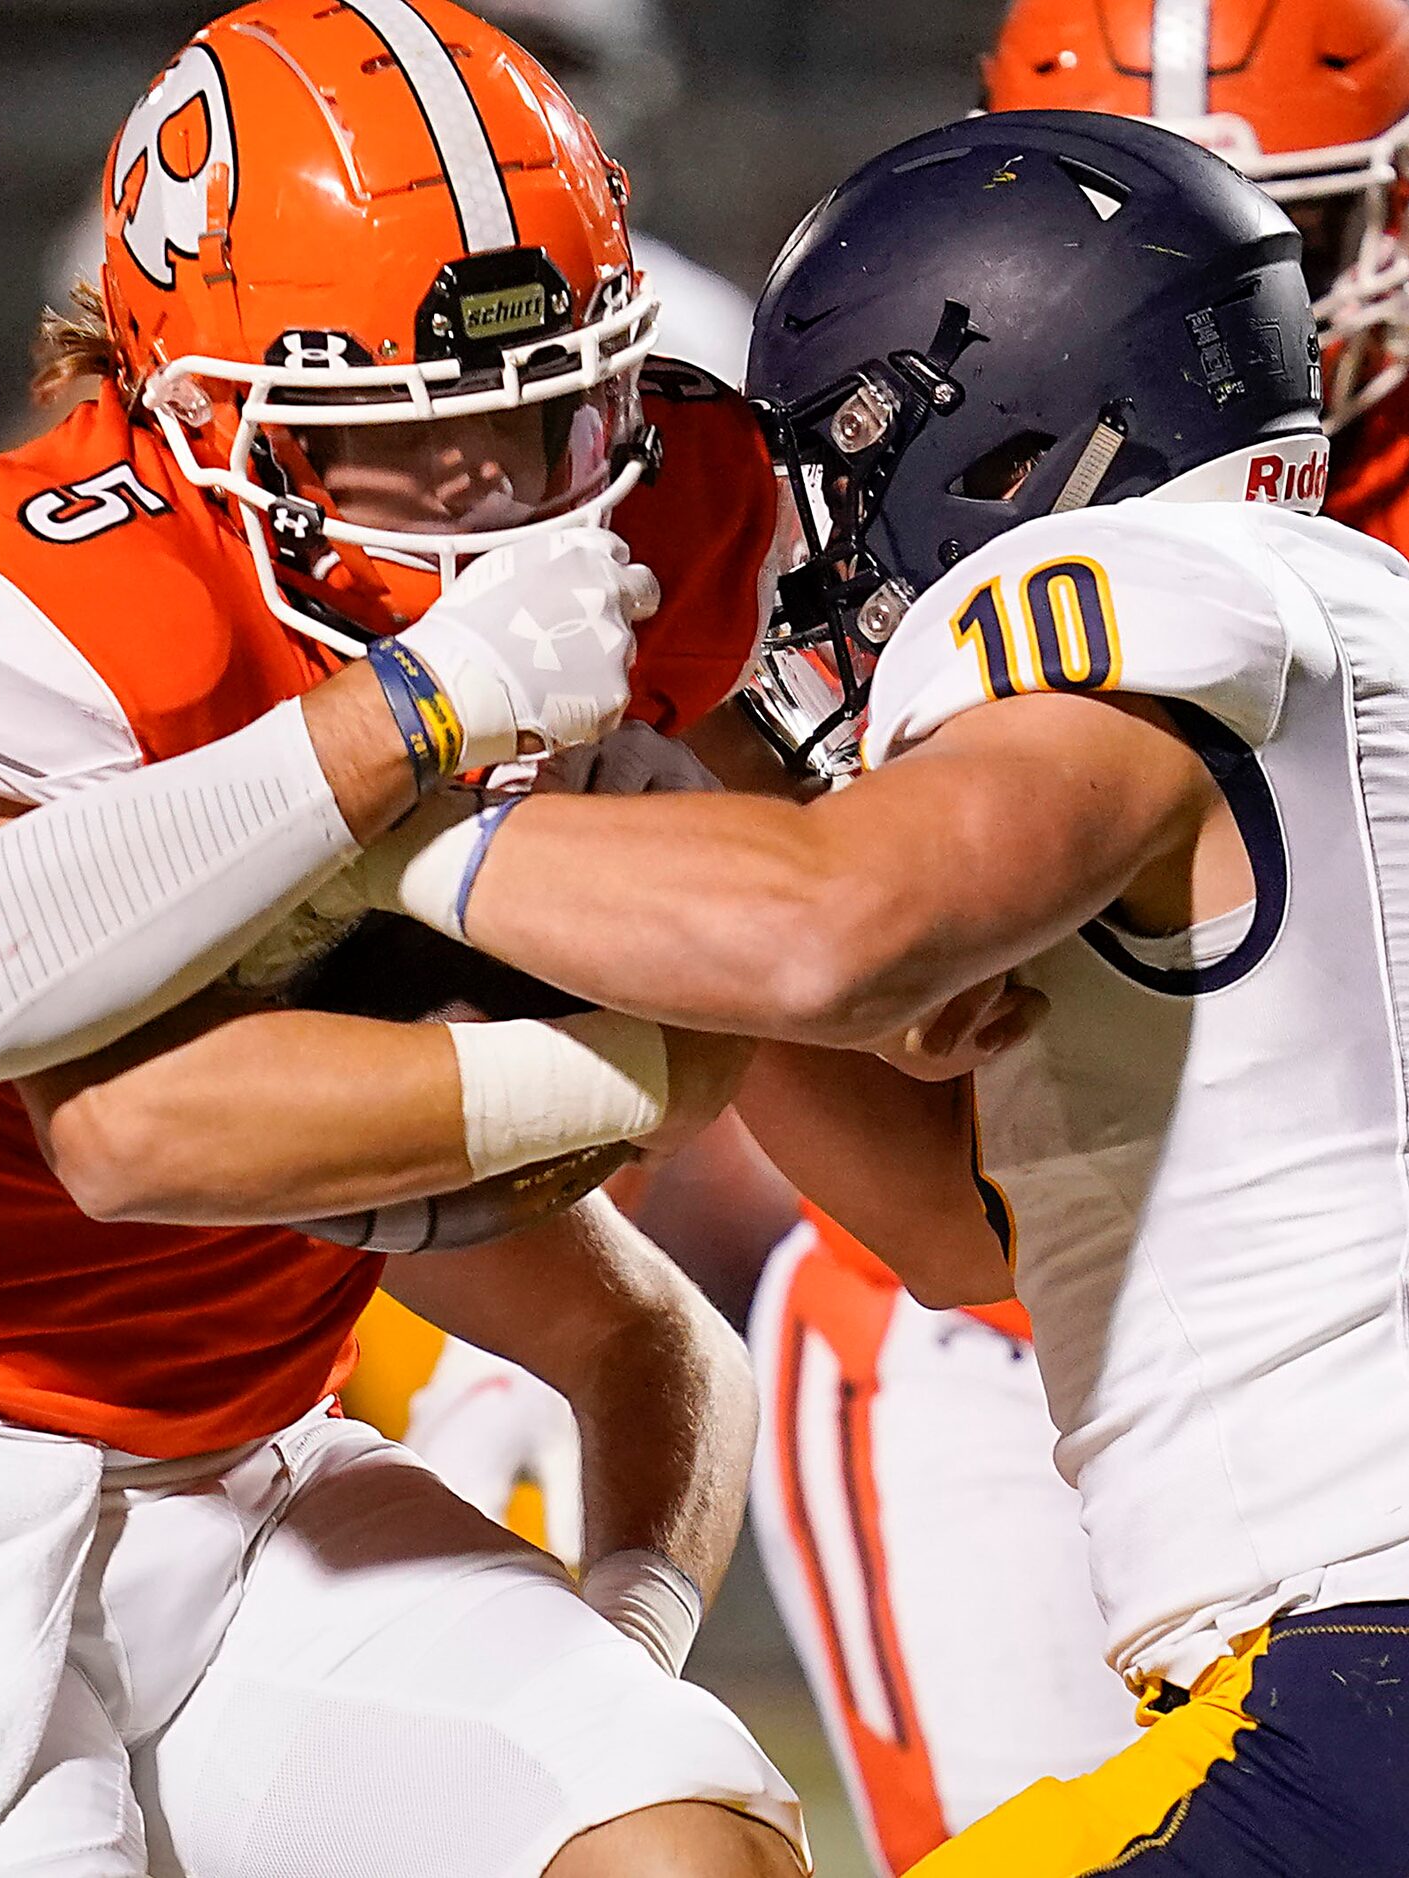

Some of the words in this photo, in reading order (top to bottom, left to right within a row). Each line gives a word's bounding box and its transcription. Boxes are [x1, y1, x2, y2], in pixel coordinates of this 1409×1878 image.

[466, 296, 542, 328] schutt
[17, 459, 175, 544] 5
[948, 555, 1123, 703] 10
